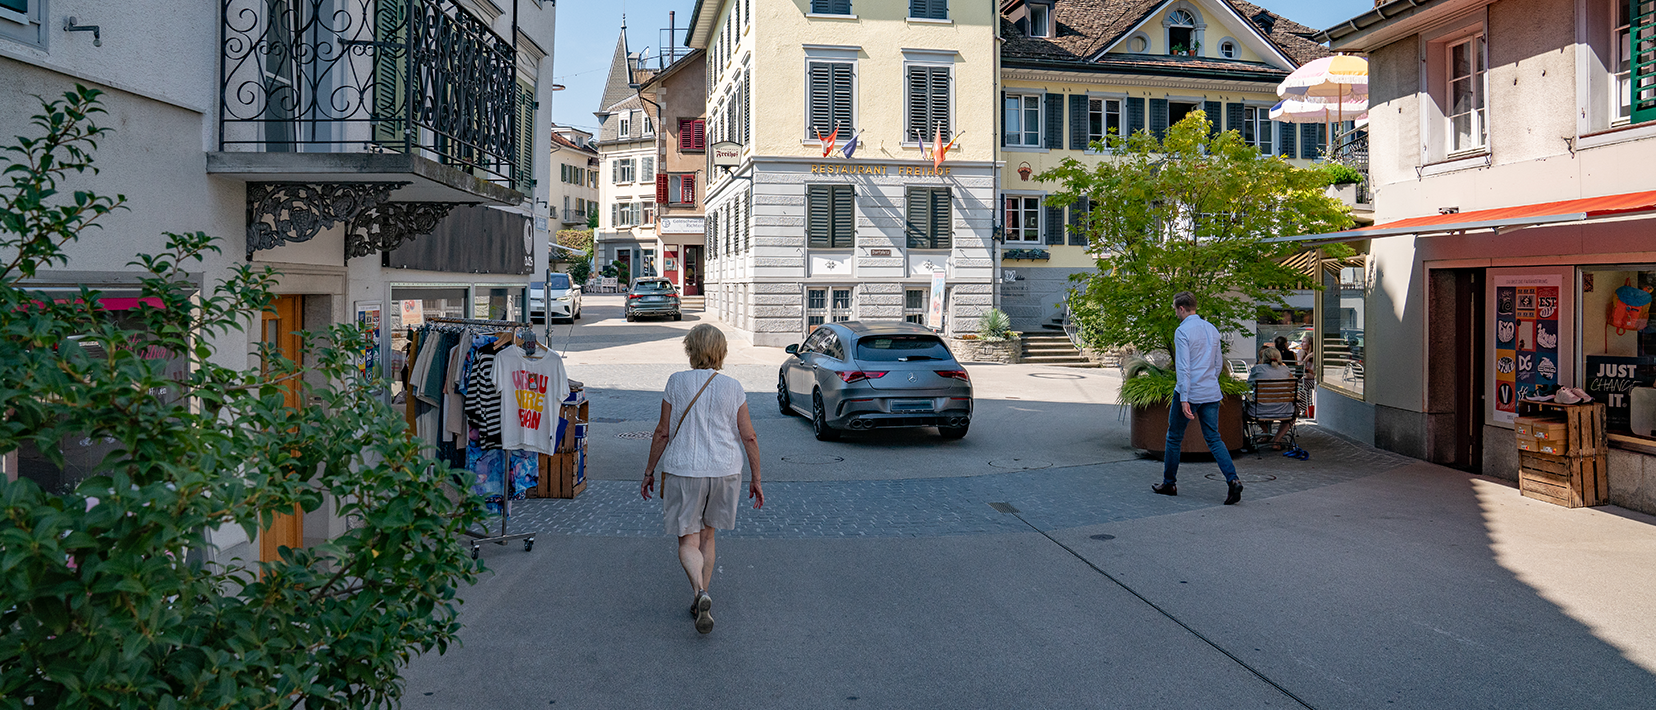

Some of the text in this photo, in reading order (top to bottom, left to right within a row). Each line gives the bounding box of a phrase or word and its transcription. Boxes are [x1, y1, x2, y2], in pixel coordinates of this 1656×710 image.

[716, 150, 738, 158] Freihof
[811, 164, 951, 176] RESTAURANT FREIHOF
[1596, 363, 1637, 378] JUST
